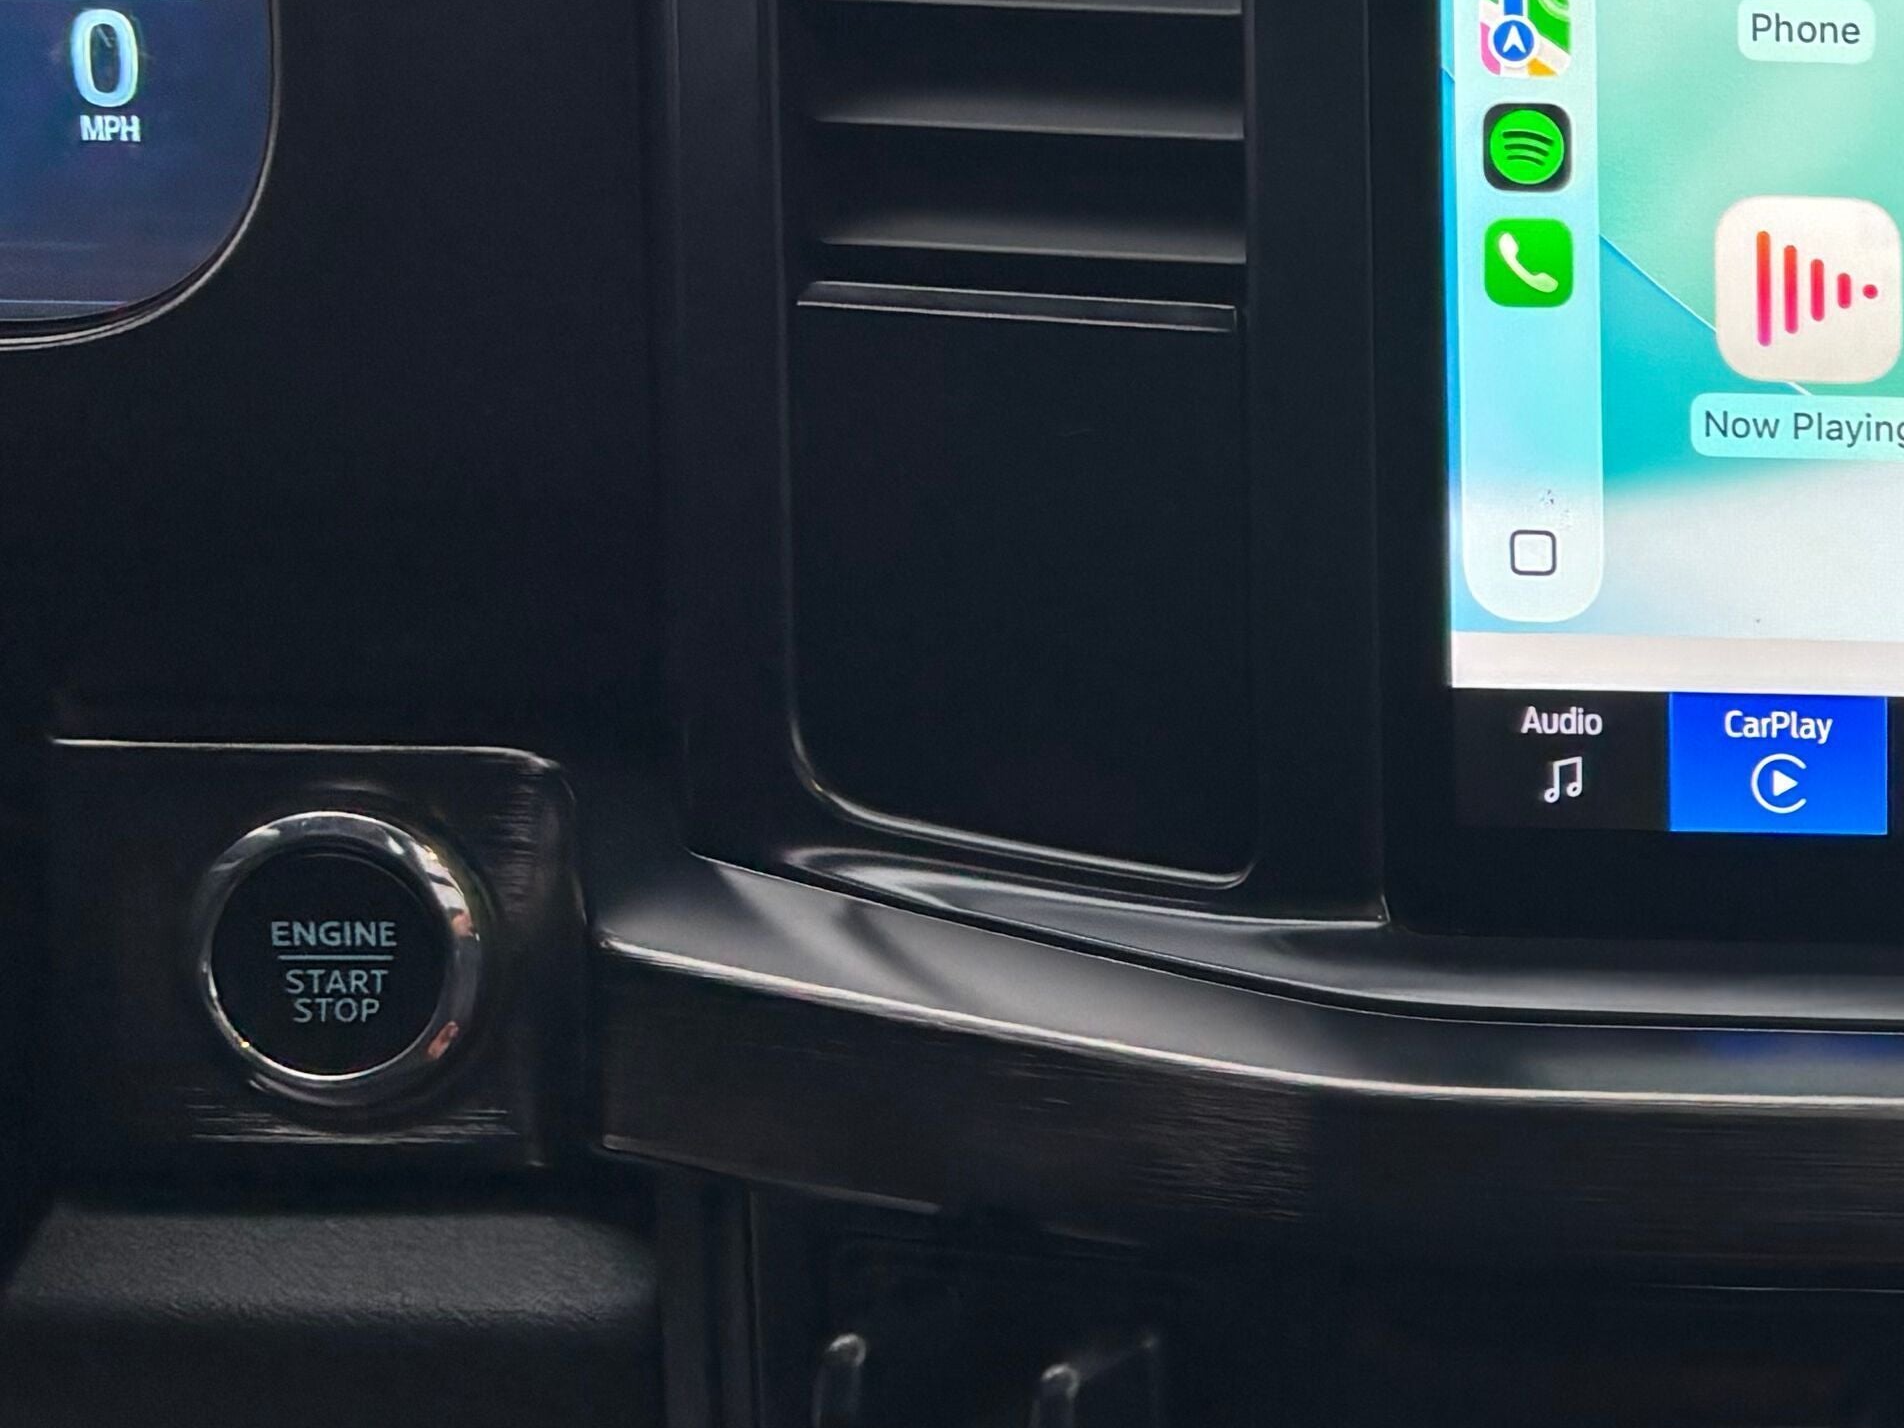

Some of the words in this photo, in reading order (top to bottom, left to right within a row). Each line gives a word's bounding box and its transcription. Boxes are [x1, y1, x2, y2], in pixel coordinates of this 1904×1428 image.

[1750, 13, 1862, 47] Phone
[71, 9, 139, 107] 0
[80, 115, 141, 142] MPH
[1703, 410, 1779, 441] Now
[1520, 706, 1603, 737] Audio
[1724, 710, 1833, 746] CarPlay
[270, 921, 397, 947] ENGINE
[285, 969, 388, 994] START
[293, 998, 380, 1023] STOP
